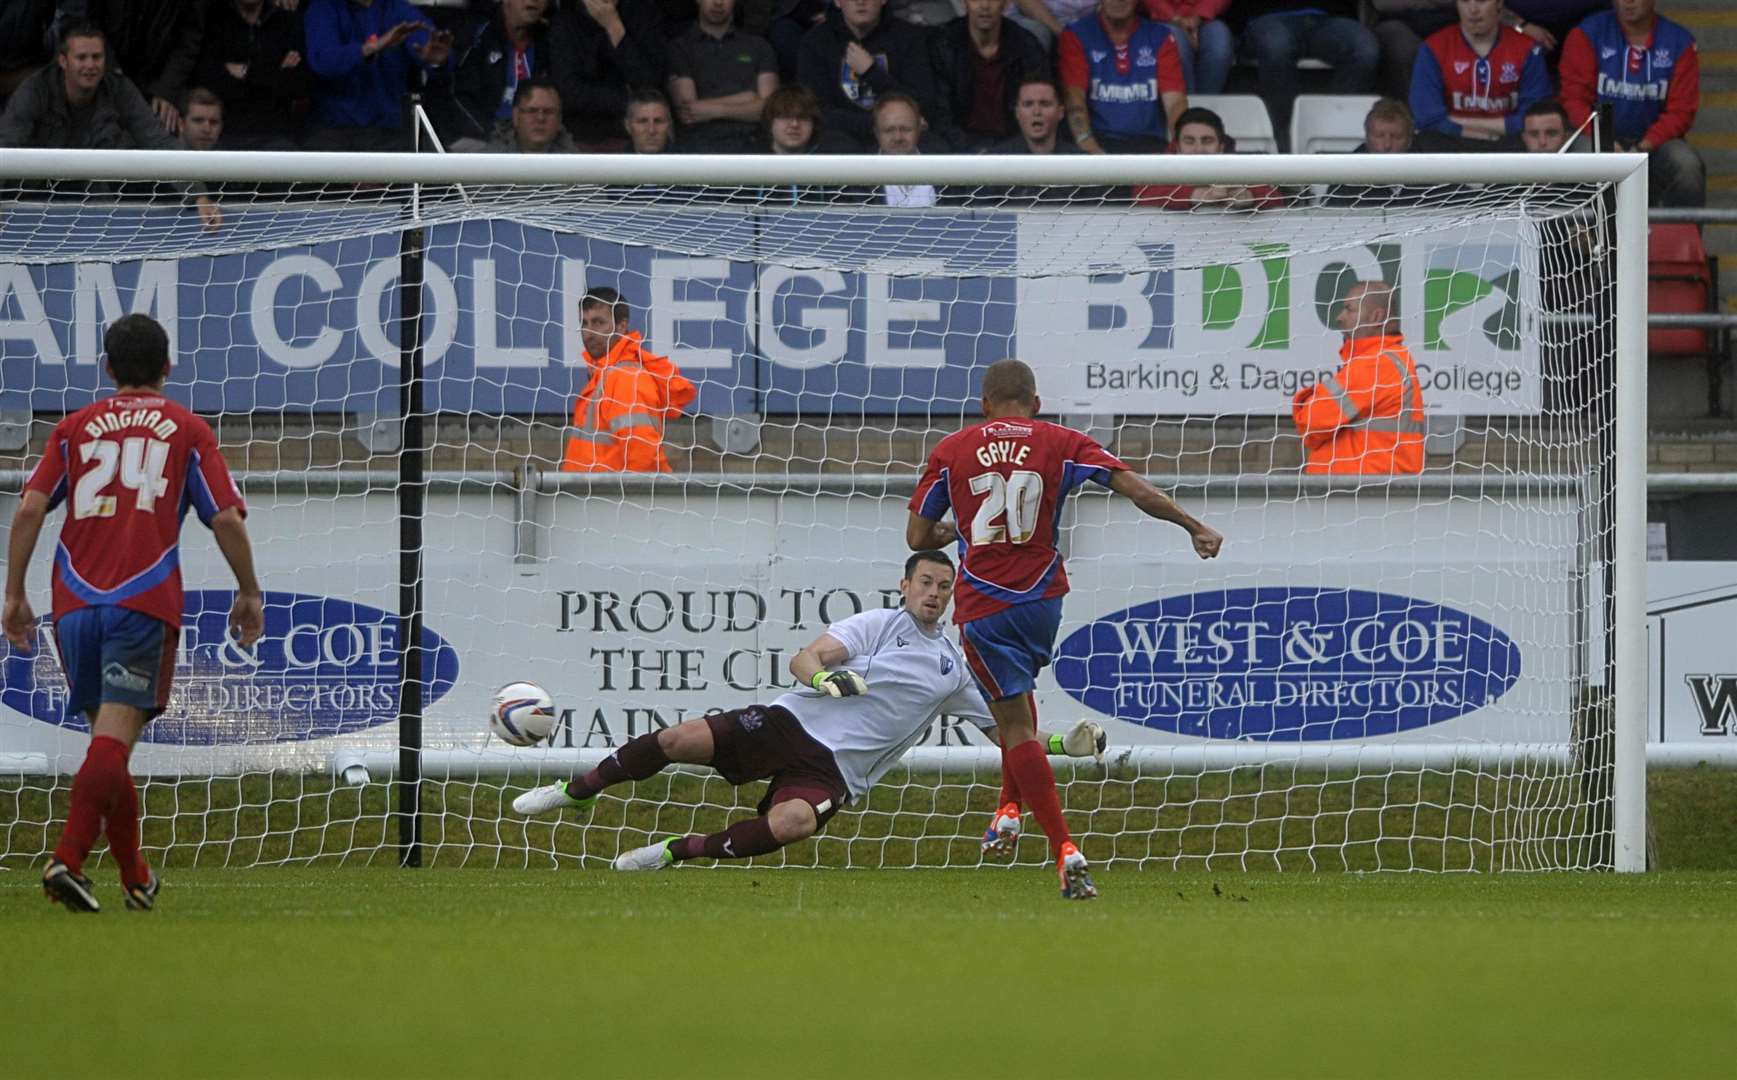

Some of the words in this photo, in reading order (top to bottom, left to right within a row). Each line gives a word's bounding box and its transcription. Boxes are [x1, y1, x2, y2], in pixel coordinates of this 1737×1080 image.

[250, 255, 947, 369] COLLEGE
[1087, 364, 1199, 396] Barking
[1209, 364, 1231, 390] &
[1241, 363, 1342, 396] Dagen
[1415, 363, 1522, 397] College
[85, 409, 178, 440] BINGHAM
[975, 440, 1031, 467] GAYLE
[74, 437, 171, 520] 24
[968, 470, 1044, 546] 20
[556, 589, 767, 632] PROUD
[781, 587, 863, 631] TO
[284, 623, 399, 667] COE
[1112, 621, 1269, 665] WEST
[1285, 620, 1334, 665] &
[1350, 620, 1464, 665] COE
[590, 648, 708, 691] THE
[207, 684, 393, 711] DIRECTORS
[1117, 681, 1267, 708] FUNERAL
[1276, 680, 1460, 708] DIRECTORS
